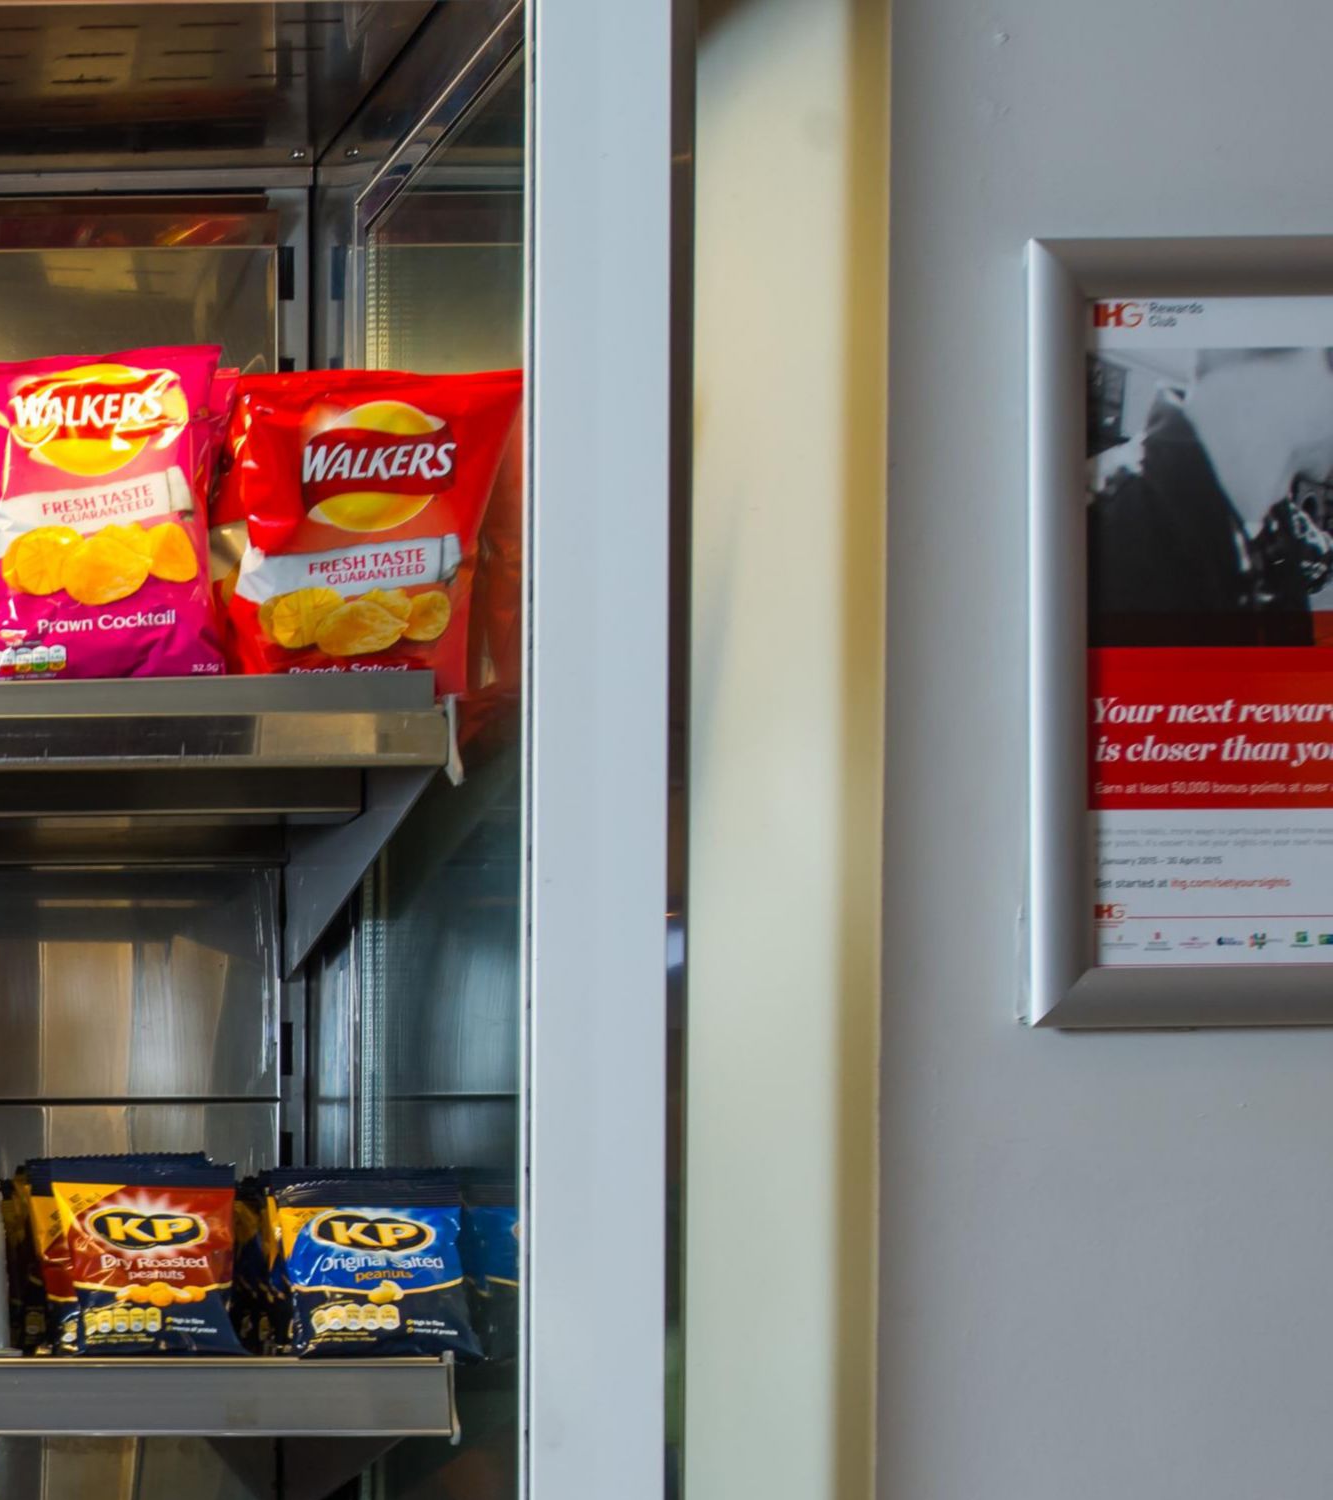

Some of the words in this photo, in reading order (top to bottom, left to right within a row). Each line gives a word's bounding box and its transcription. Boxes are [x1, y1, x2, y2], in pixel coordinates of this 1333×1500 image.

[1093, 302, 1143, 328] IHG
[1149, 302, 1204, 314] Rewards
[1149, 314, 1177, 328] Club
[13, 391, 164, 430] WALKERS
[301, 441, 457, 483] WALKERS
[41, 495, 100, 517] FRESH
[100, 484, 153, 508] TASTE
[60, 496, 156, 525] GUARANTEED
[307, 555, 367, 577] FRESH
[371, 547, 427, 568] TASTE
[325, 563, 427, 586] GUARANTEED
[37, 614, 94, 635] Prawn
[97, 609, 177, 631] Cocktail
[1093, 696, 1164, 724] Your
[1166, 698, 1236, 724] next
[1237, 702, 1333, 724] rewar
[1094, 736, 1121, 763] is
[1124, 734, 1217, 763] closer
[1220, 734, 1290, 763] than
[1290, 741, 1333, 768] yo
[1094, 782, 1124, 795] Earn
[1125, 783, 1137, 795] at
[1140, 782, 1169, 795] least
[1171, 781, 1210, 796] 50,000
[1212, 781, 1248, 794] bonus
[1249, 782, 1287, 796] points
[1288, 782, 1300, 794] at
[1302, 783, 1329, 793] over
[1115, 878, 1155, 889] started
[1156, 878, 1168, 889] at
[104, 1217, 197, 1246] KP
[333, 1221, 419, 1248] KP
[100, 1255, 133, 1274] Dry
[136, 1255, 208, 1270] Roasted
[128, 1269, 186, 1283] peanuts
[353, 1268, 414, 1283] peanuts
